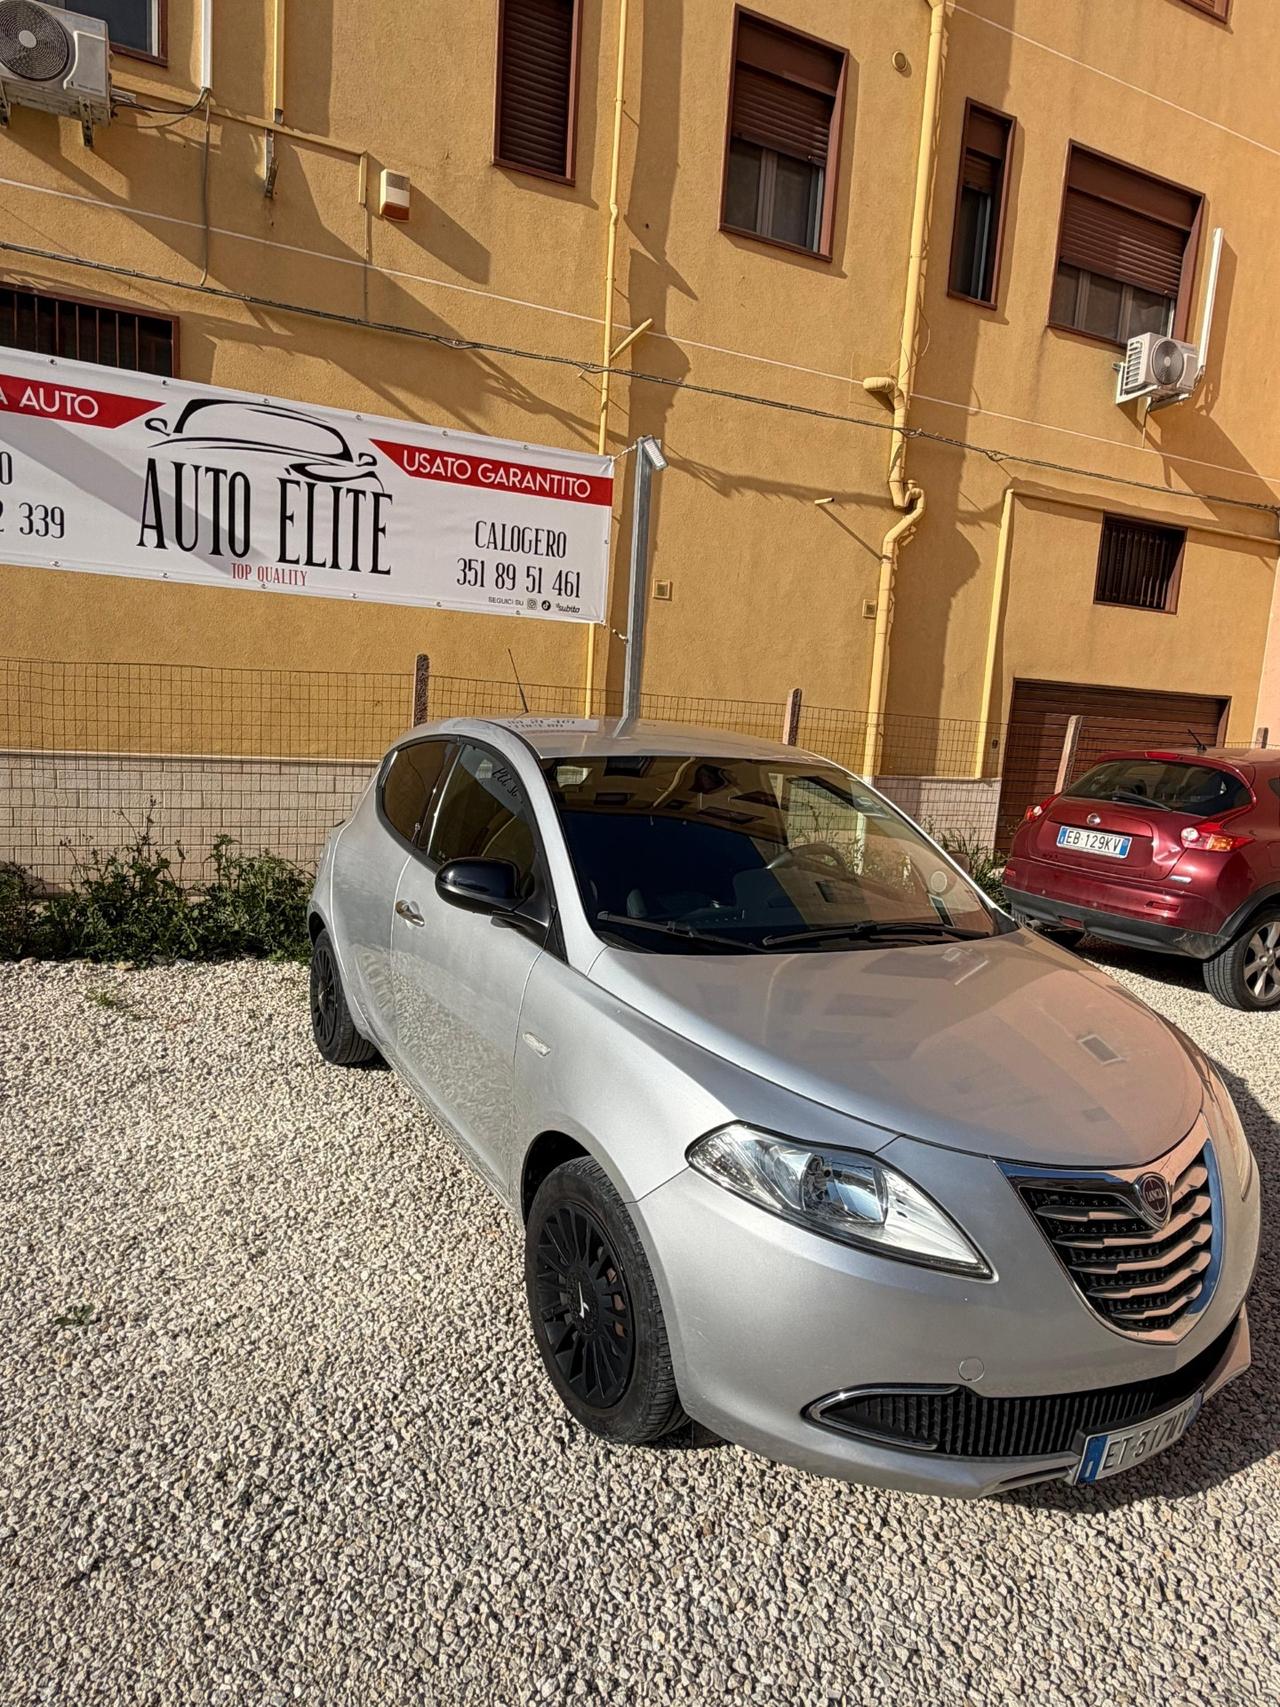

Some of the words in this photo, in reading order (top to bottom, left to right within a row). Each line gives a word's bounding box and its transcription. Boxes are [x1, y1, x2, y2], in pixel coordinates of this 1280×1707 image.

[20, 386, 99, 419] AUTO
[403, 449, 471, 481] USATO
[477, 462, 591, 498] GARANTITO
[19, 502, 65, 539] 339
[136, 458, 251, 558] AUTO
[276, 467, 392, 575] ÈLITE
[475, 520, 567, 558] CALOGERO
[231, 562, 252, 580] TOP
[257, 565, 308, 587] QUALITY
[456, 558, 485, 588] 351
[495, 563, 516, 591] 89
[525, 566, 543, 594] 51
[552, 569, 581, 598] 461
[1065, 830, 1081, 845] EB
[1084, 833, 1122, 852] 129KV
[1101, 1434, 1134, 1472] ET
